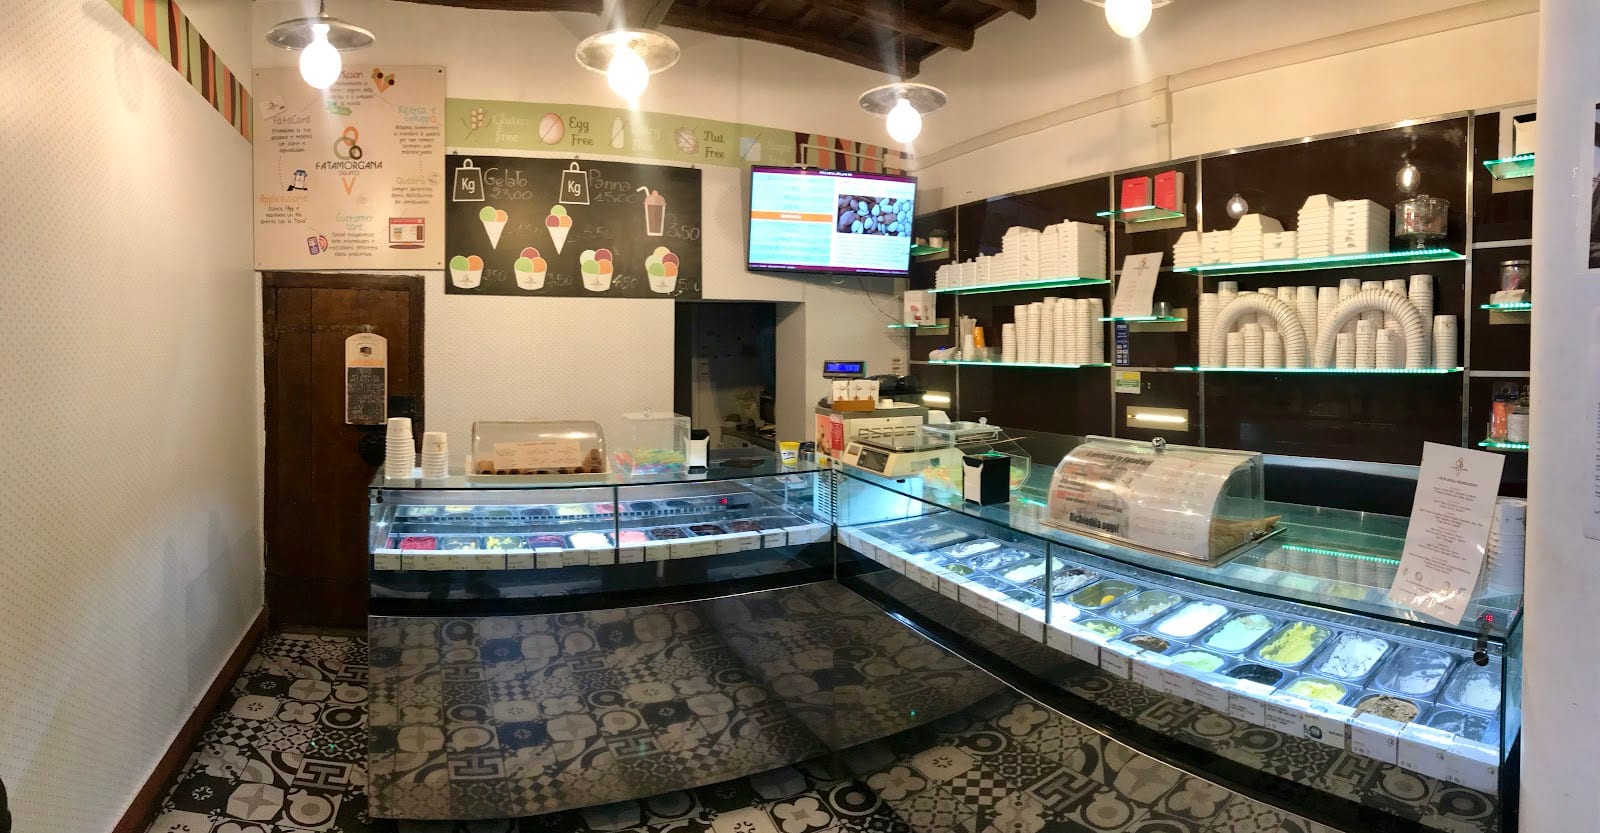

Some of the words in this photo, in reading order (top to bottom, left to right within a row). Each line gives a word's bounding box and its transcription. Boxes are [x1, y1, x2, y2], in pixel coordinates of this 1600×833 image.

[569, 117, 589, 133] Egg
[495, 131, 519, 144] Free
[571, 134, 594, 146] Free
[704, 131, 724, 144] Nut
[705, 147, 725, 159] Free
[315, 161, 383, 171] FATAMORGANA
[462, 177, 475, 194] Kg
[483, 167, 528, 188] Gelato
[568, 180, 581, 197] Kg
[589, 168, 631, 193] Panna
[667, 222, 700, 241] 3,50
